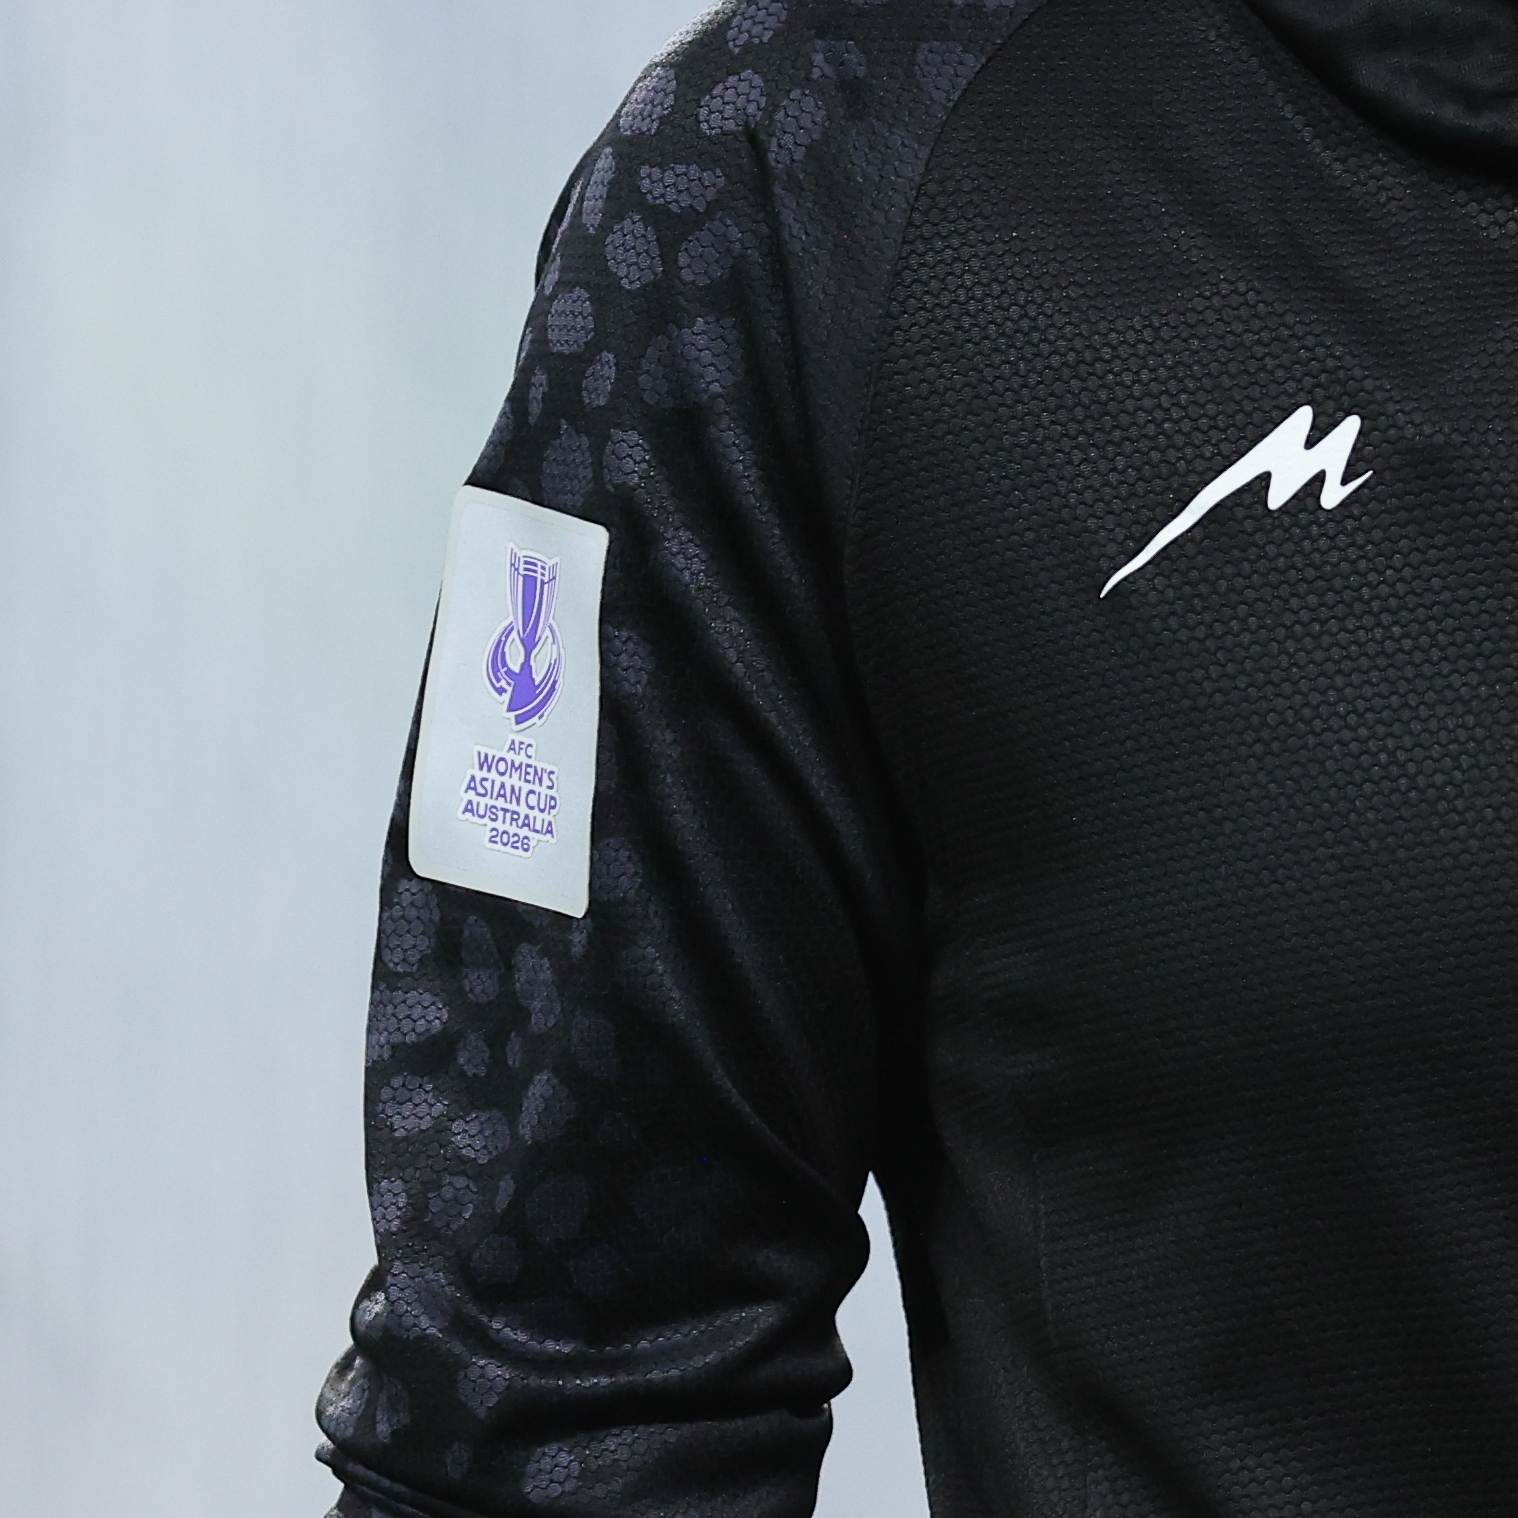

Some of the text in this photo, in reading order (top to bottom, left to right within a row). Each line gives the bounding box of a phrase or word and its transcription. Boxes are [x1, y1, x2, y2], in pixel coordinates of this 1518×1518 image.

[507, 739, 533, 759] AFC
[477, 750, 555, 790] WOMEN'S
[464, 774, 557, 815] ASIAN CUP
[462, 799, 554, 838] AUSTRALIA
[488, 827, 531, 852] 2026
